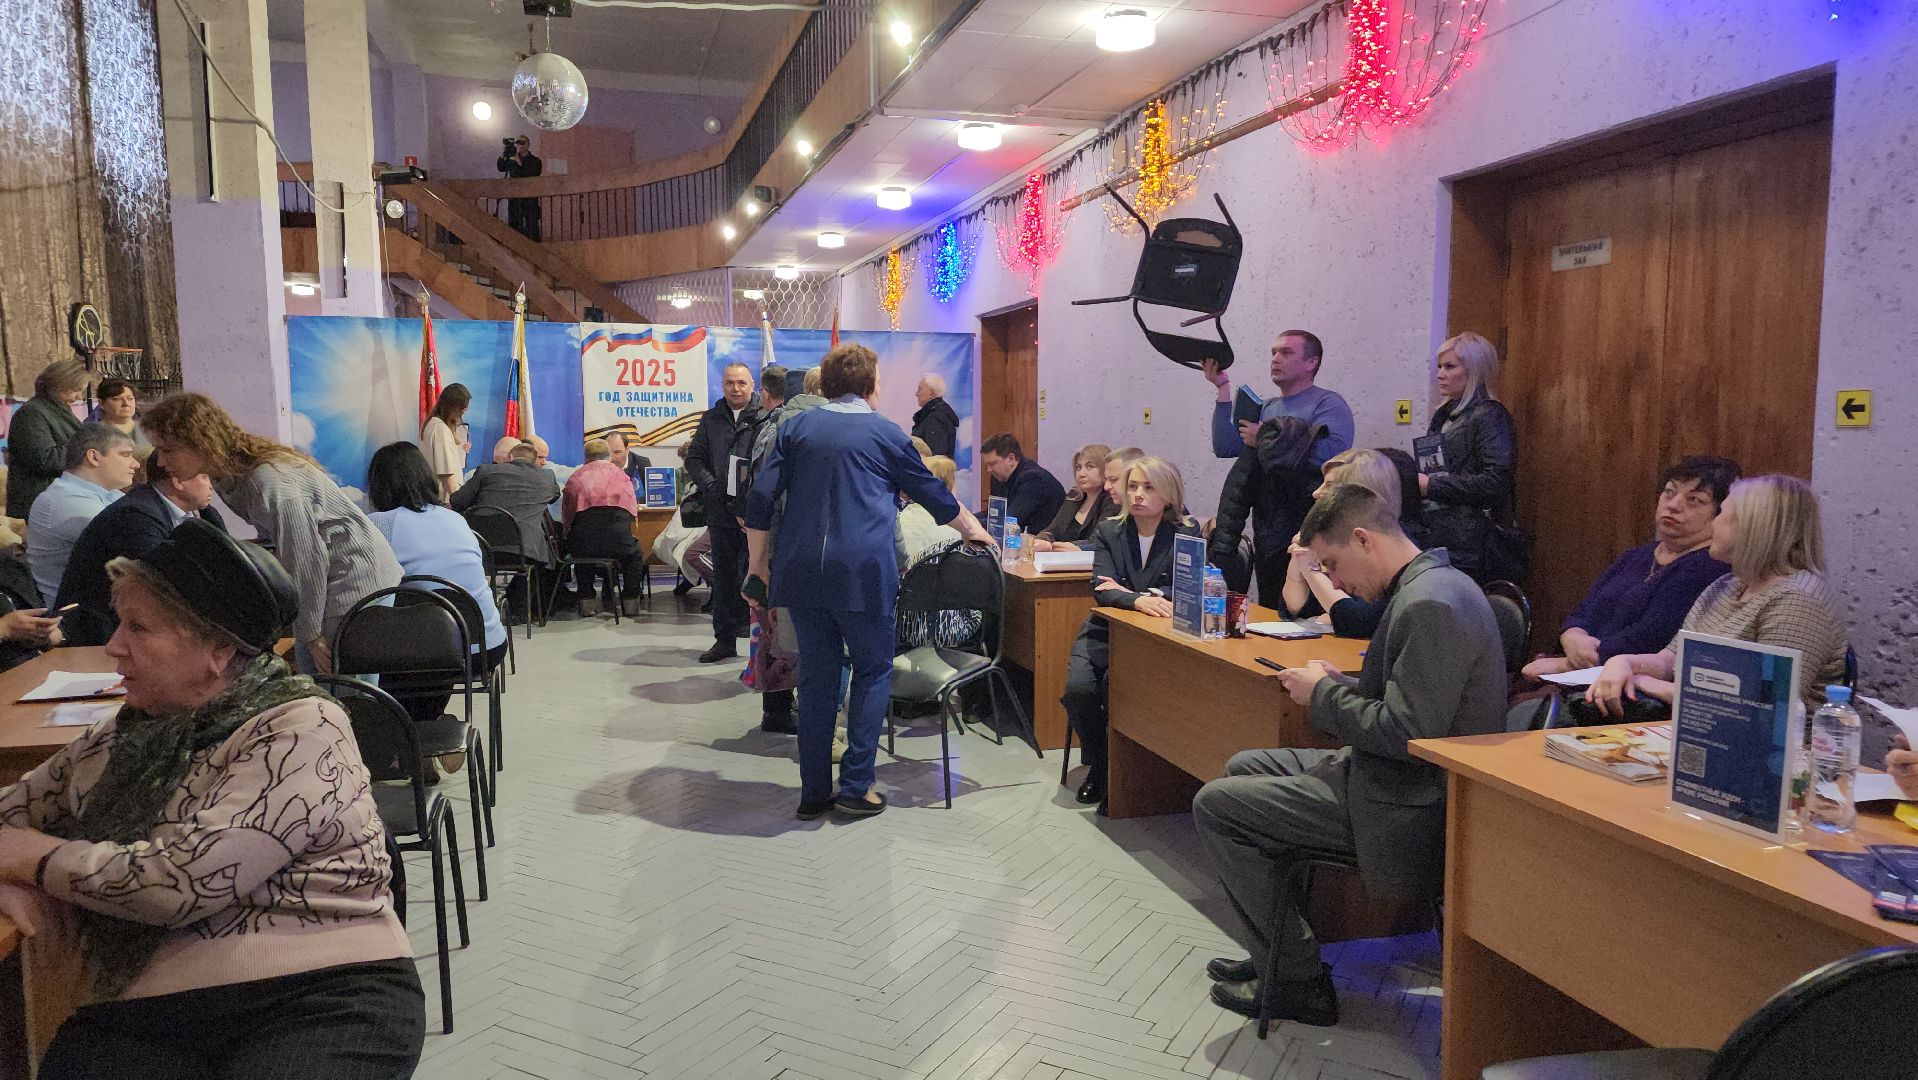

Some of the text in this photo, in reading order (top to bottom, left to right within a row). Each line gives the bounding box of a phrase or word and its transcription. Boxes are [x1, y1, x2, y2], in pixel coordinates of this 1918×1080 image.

[615, 358, 676, 387] 2025
[598, 391, 694, 403] ГОД ЗАЩИТНИКА
[616, 406, 678, 418] ОТЕЧЕСТВА
